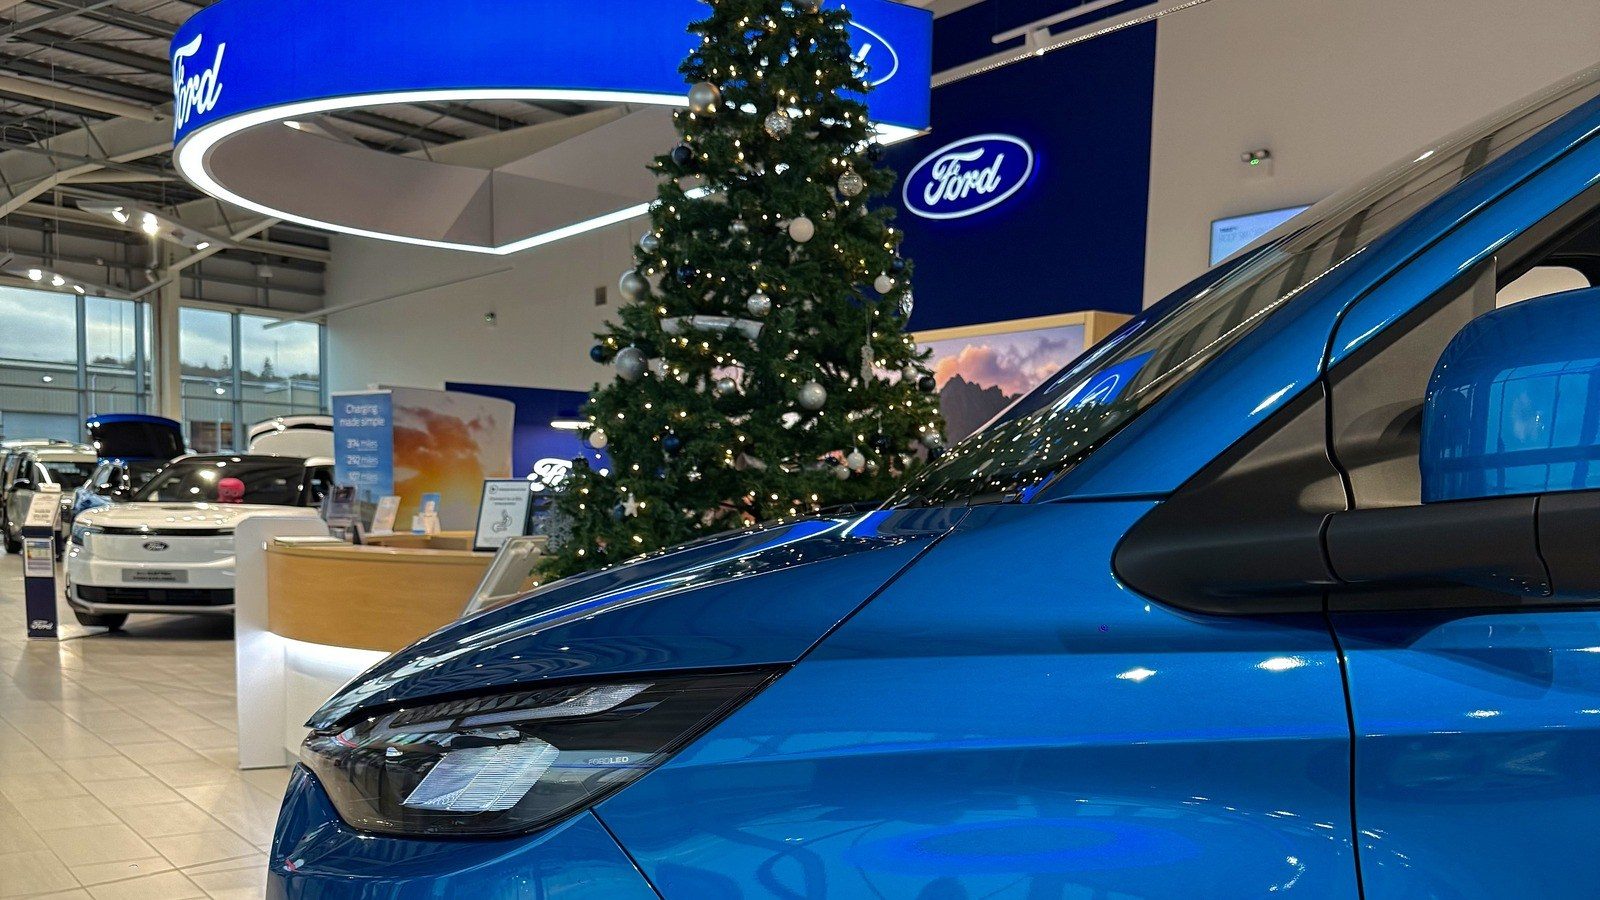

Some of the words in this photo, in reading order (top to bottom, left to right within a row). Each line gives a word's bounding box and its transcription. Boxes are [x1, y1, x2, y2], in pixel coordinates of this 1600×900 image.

[172, 33, 226, 139] Ford
[923, 147, 1005, 206] Ford
[339, 417, 360, 428] made
[361, 417, 386, 428] simple
[345, 404, 379, 416] Charging
